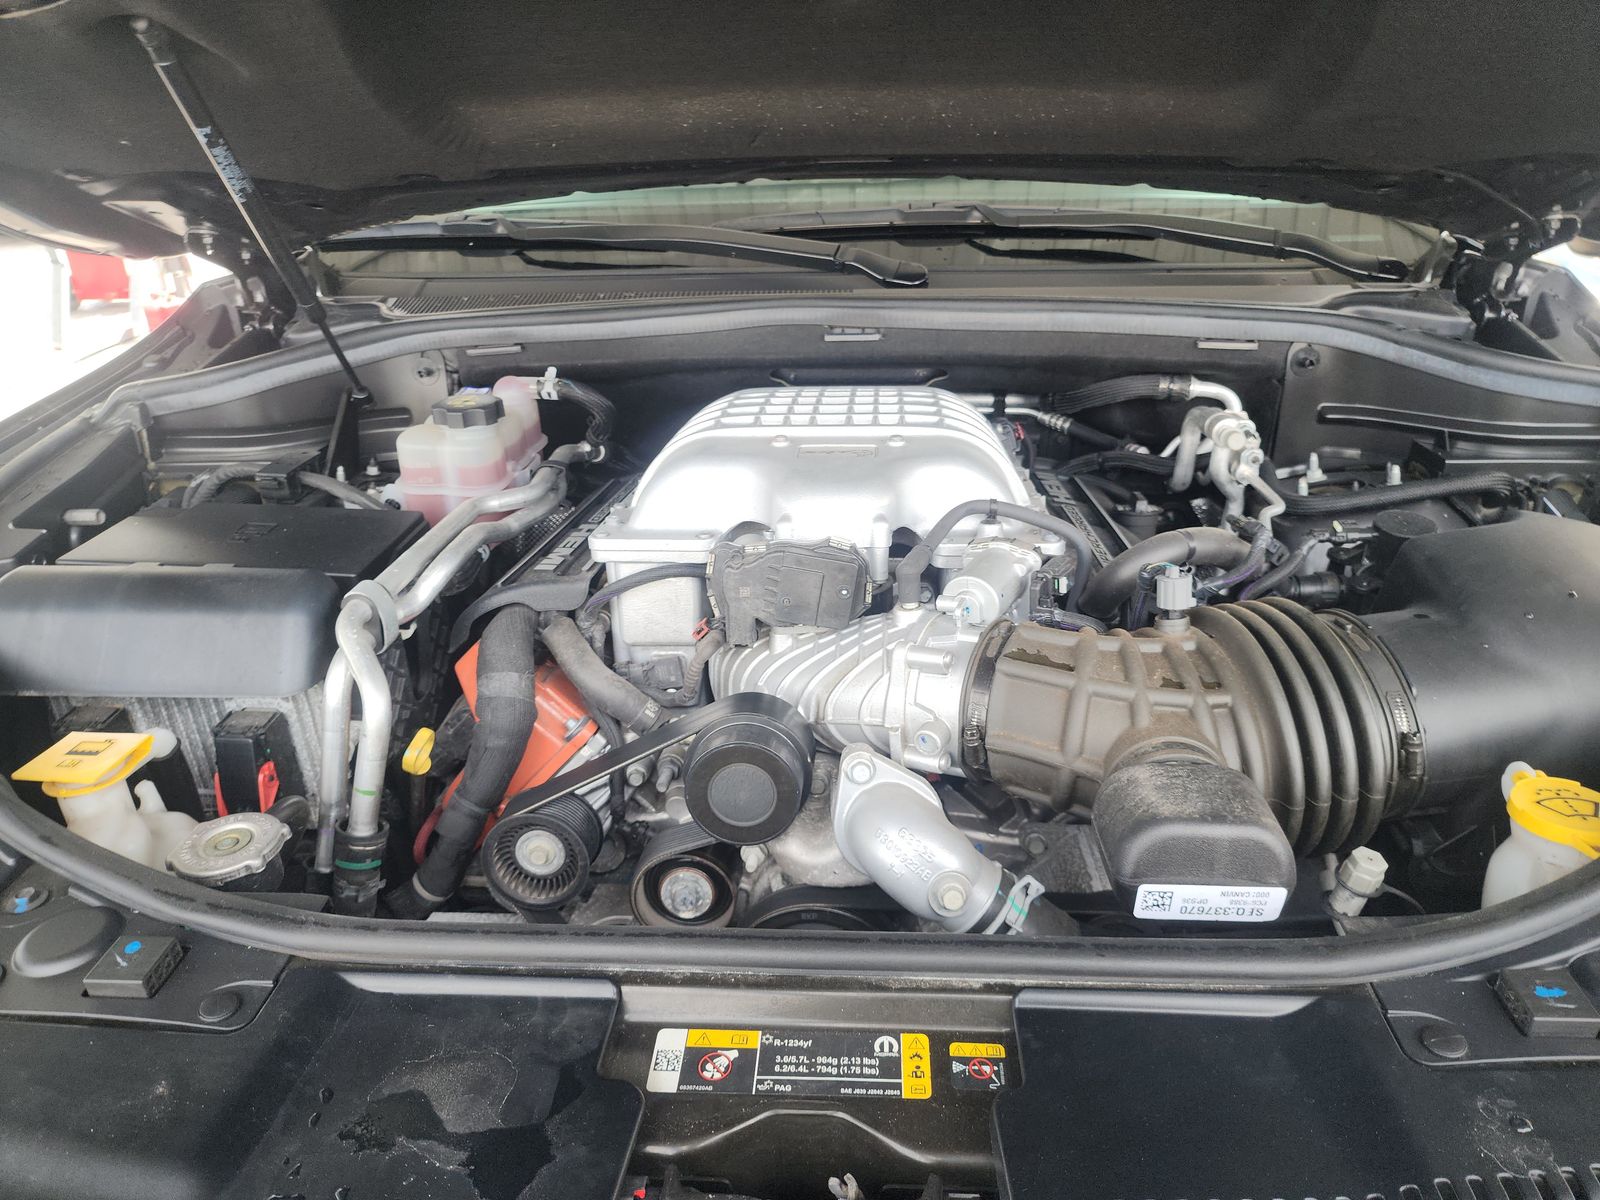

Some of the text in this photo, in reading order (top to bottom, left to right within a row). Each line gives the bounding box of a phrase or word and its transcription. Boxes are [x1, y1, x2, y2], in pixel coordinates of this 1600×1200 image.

[534, 523, 600, 571] HEMI
[774, 1039, 812, 1048] R-1234yf
[775, 1055, 810, 1064] 3.6/5.7L
[816, 1056, 838, 1065] 964g
[840, 1057, 861, 1066] (2.13
[862, 1057, 879, 1066] lbs)
[774, 1065, 809, 1073] 6.2/6.4L
[816, 1065, 838, 1075] 794g
[840, 1066, 861, 1075] (1.75
[862, 1067, 879, 1076] lbs)
